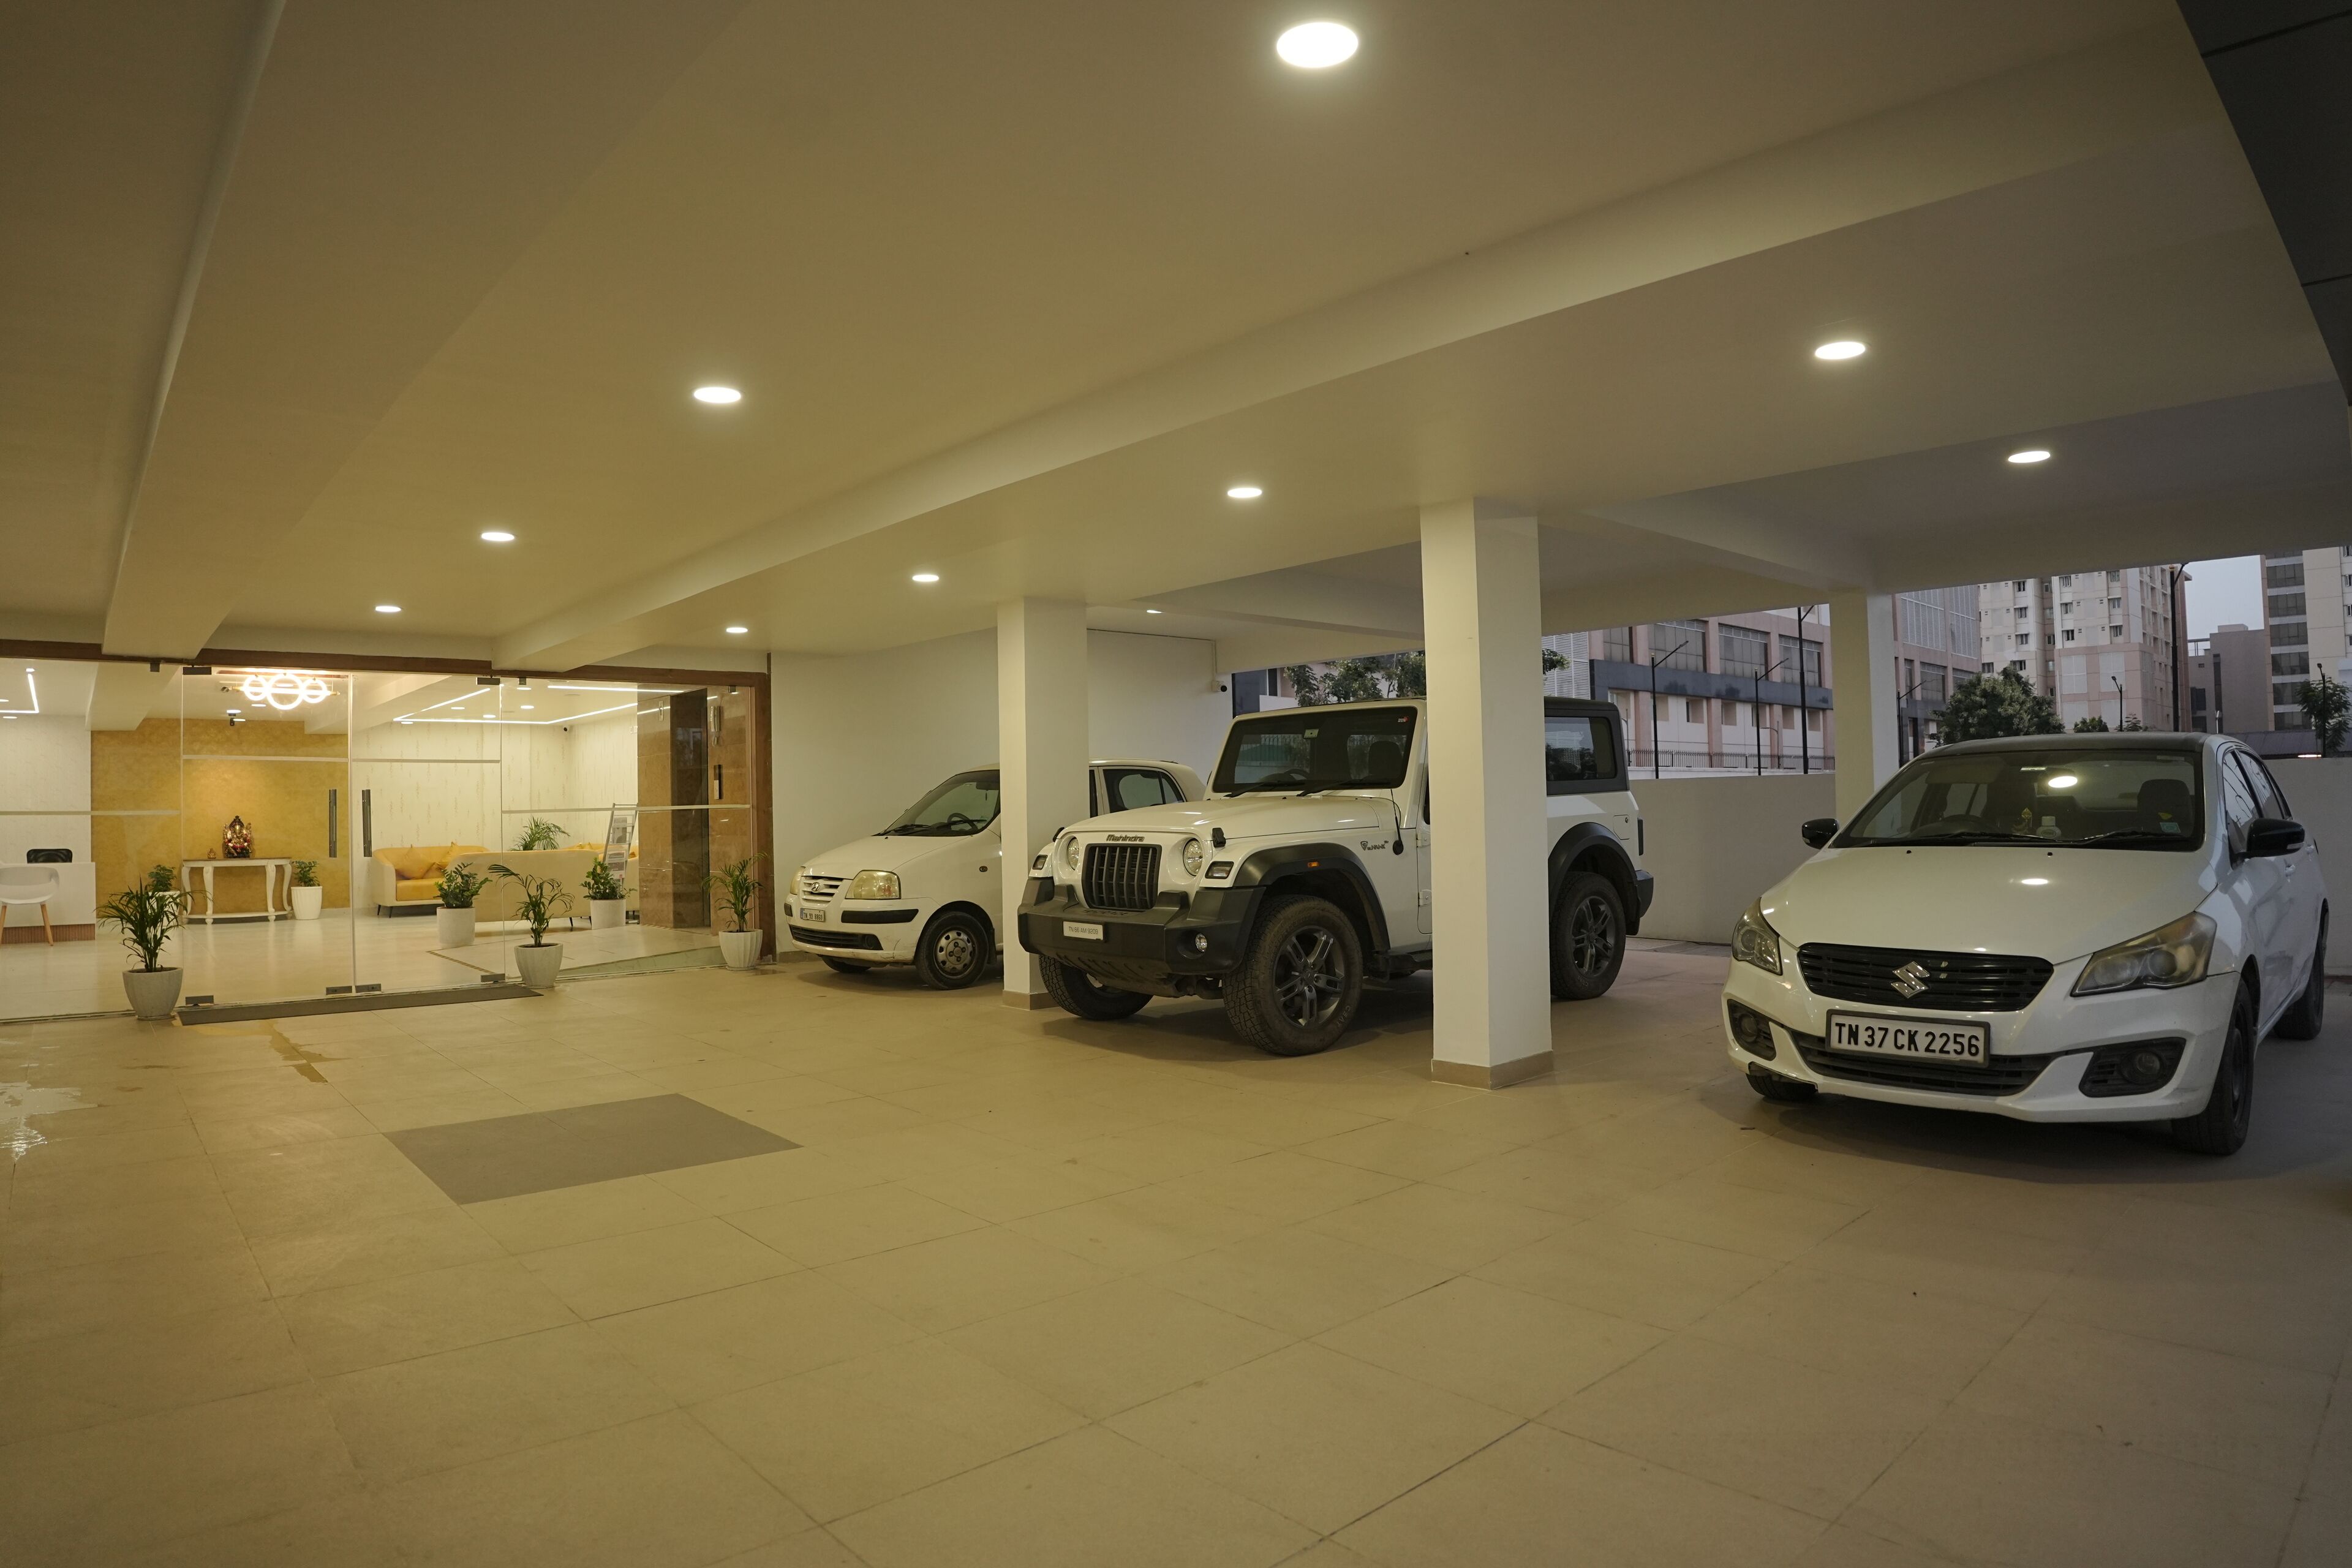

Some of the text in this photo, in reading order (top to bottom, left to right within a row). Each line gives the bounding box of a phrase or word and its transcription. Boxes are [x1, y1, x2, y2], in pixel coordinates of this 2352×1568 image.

[1835, 1022, 1980, 1056] TN 37 CK 2256
